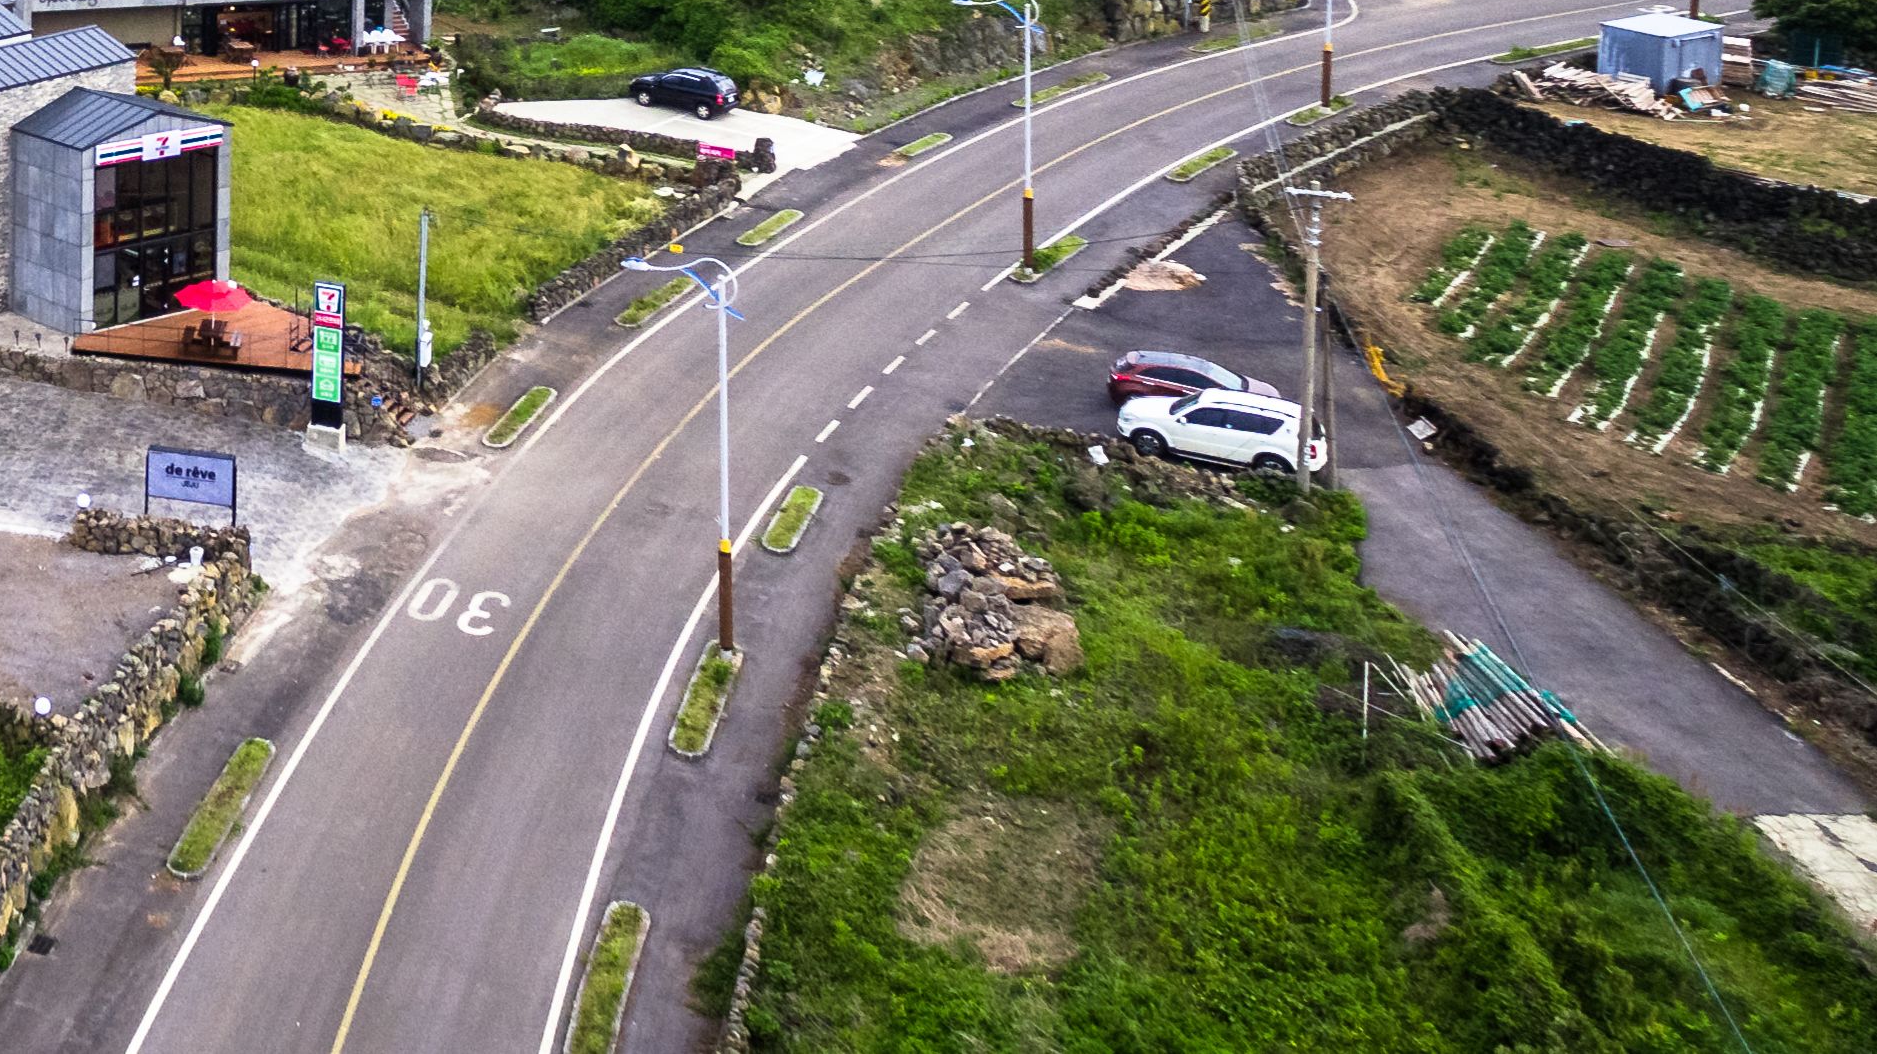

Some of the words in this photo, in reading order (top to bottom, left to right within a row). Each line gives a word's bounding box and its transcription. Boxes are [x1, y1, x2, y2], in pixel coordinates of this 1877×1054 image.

[165, 463, 183, 476] de
[186, 466, 216, 481] rêve
[407, 578, 511, 636] 30
